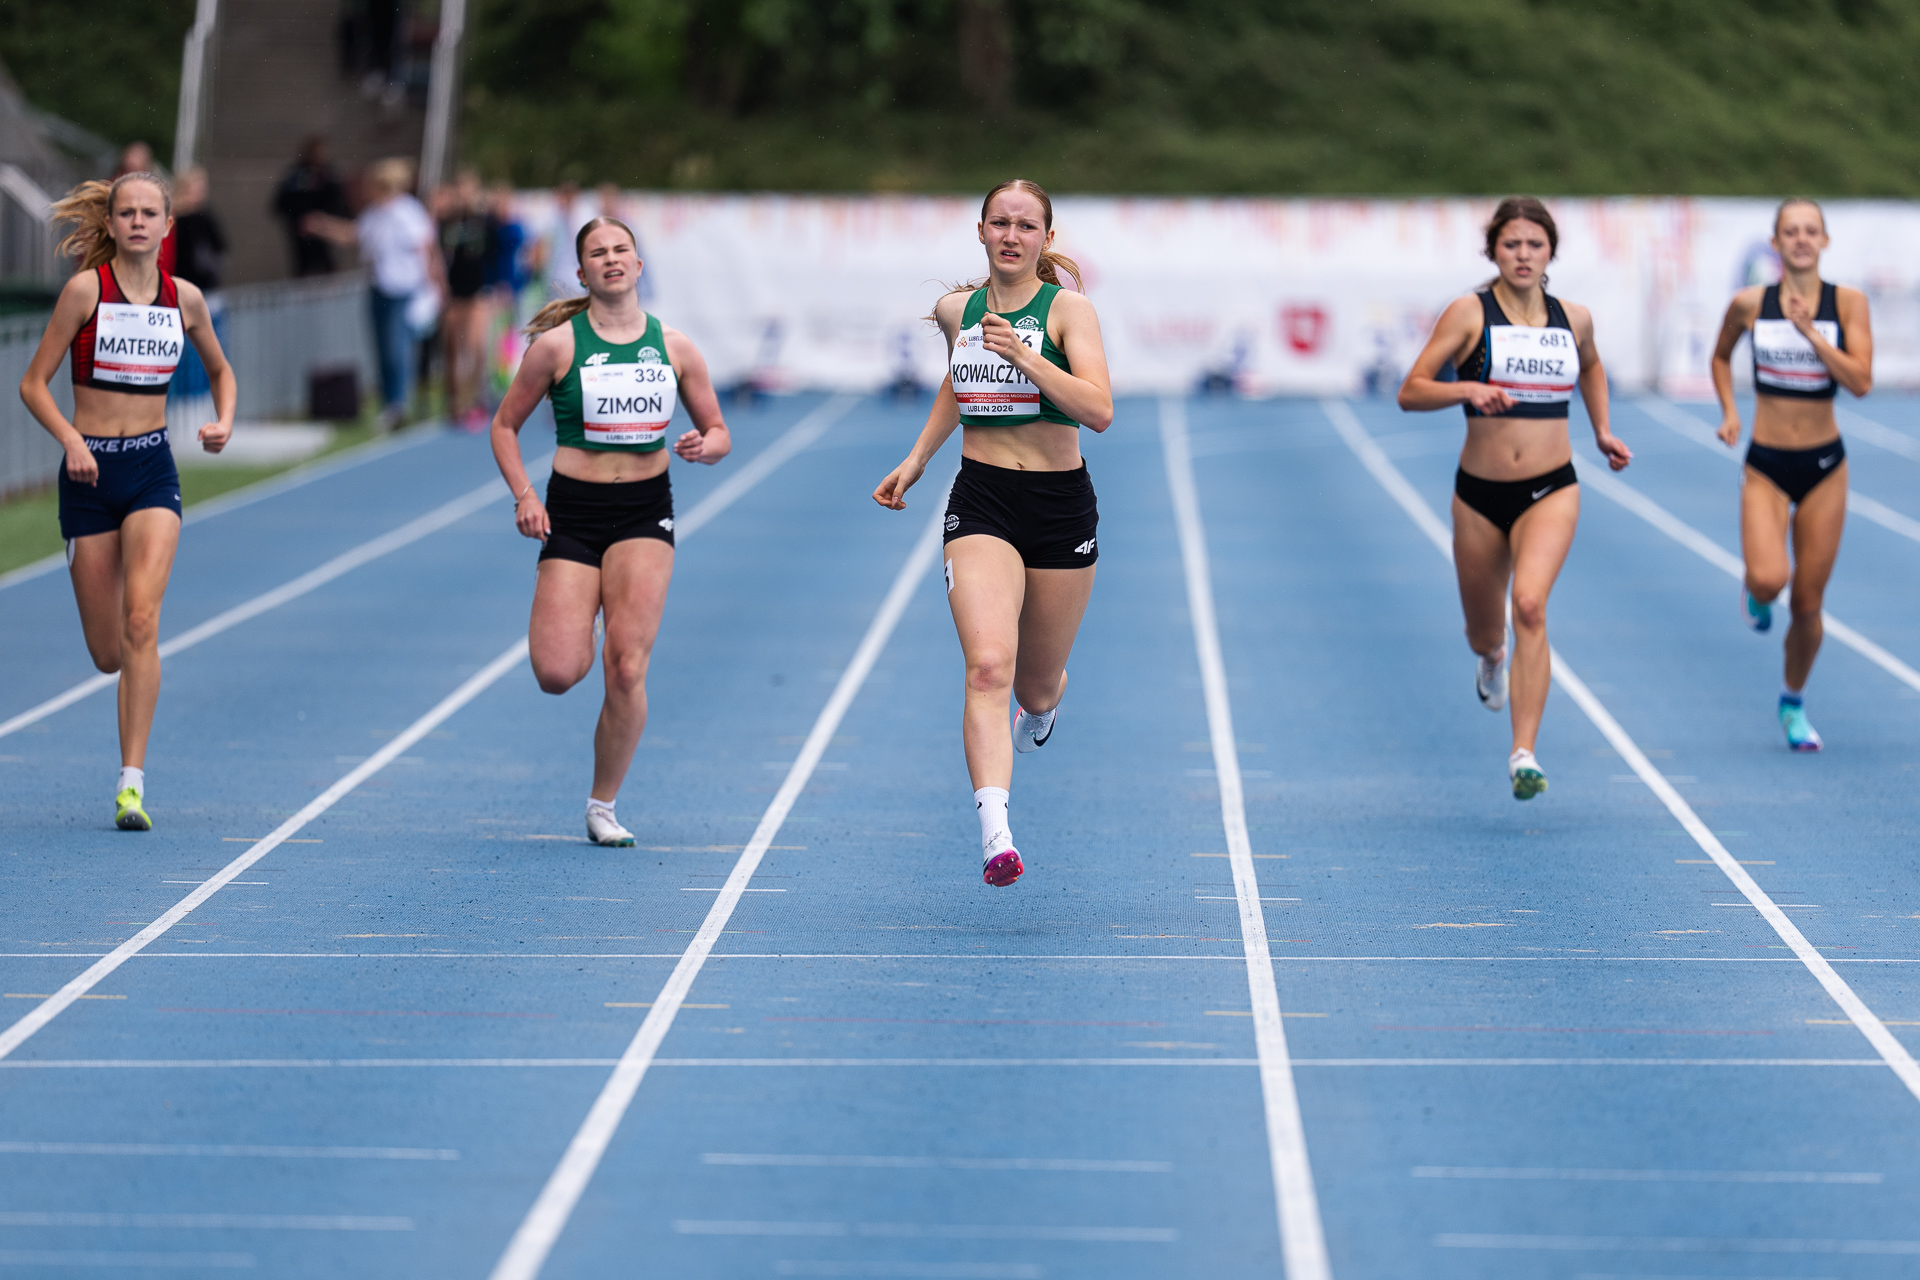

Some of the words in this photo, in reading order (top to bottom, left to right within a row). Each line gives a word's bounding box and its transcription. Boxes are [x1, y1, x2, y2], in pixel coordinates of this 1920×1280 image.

[148, 311, 173, 328] 891
[99, 336, 178, 357] MATERKA
[1539, 332, 1568, 348] 681
[634, 368, 667, 382] 336
[953, 364, 1029, 384] KOWALCZY
[1506, 357, 1564, 376] FABISZ
[597, 392, 662, 414] ZIMOŃ
[991, 404, 1014, 412] 2026
[122, 432, 162, 452] PRO
[1074, 537, 1096, 555] 4F
